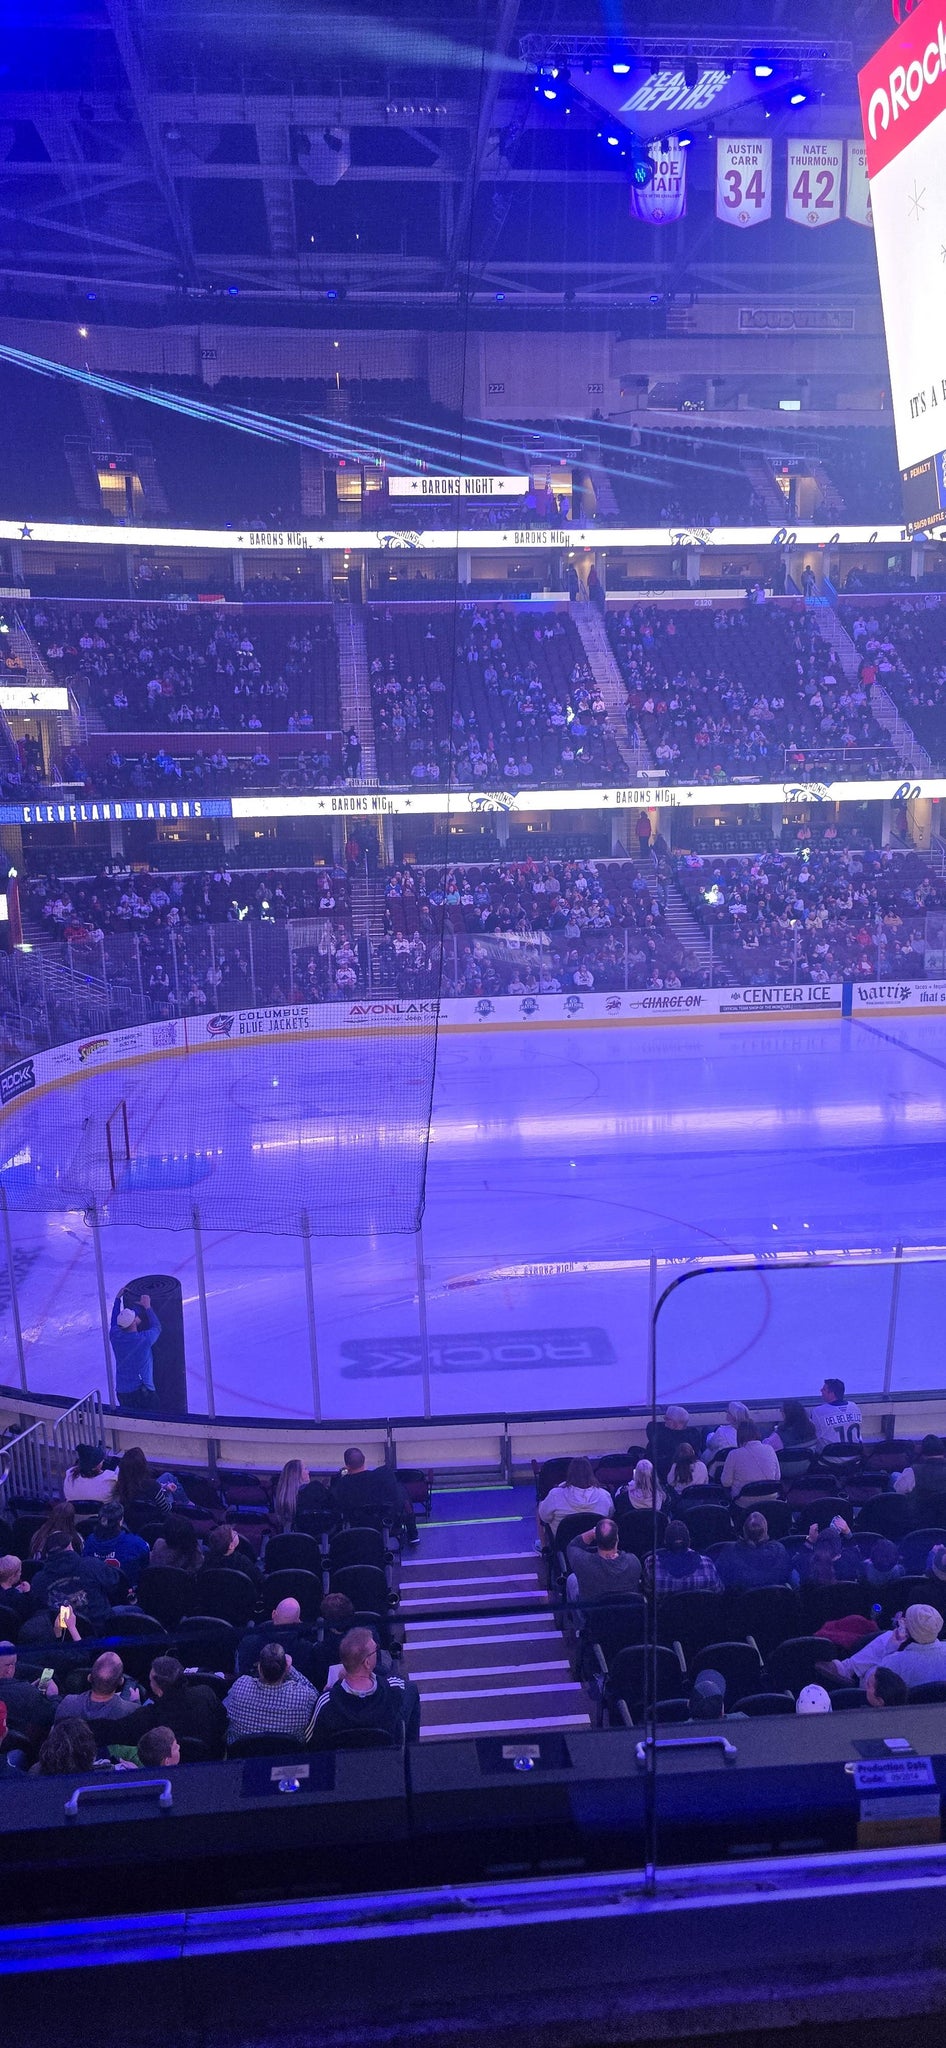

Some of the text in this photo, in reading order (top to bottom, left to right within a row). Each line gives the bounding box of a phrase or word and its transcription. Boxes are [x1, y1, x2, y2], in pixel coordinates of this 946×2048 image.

[644, 71, 692, 87] FEA
[618, 85, 723, 111] DEPTHS
[726, 144, 763, 154] AUSTIN
[802, 145, 827, 155] NATE
[653, 161, 679, 175] JOE
[731, 156, 758, 166] CARR
[790, 156, 839, 166] THURMOND
[650, 177, 682, 191] TAIT
[723, 169, 766, 208] 34
[792, 170, 835, 209] 42
[489, 384, 504, 393] 222
[588, 384, 603, 393] 223
[909, 385, 938, 419] IT'S A
[421, 478, 494, 494] BARONS NIGHT
[927, 512, 944, 526] RAFFLE
[249, 533, 284, 546] BARONS
[514, 531, 547, 544] BARONS
[616, 790, 651, 803] BARONS
[331, 798, 368, 811] BARONS
[23, 801, 202, 823] CLEVELAND BARONS
[743, 986, 831, 1003] CENTER ICE
[919, 991, 938, 1003] that
[642, 995, 702, 1009] CHARGE ON
[239, 1007, 309, 1021] COLUMBUS
[239, 1017, 310, 1034] BLUE JACKETS
[2, 1065, 31, 1093] ROCK
[833, 1423, 861, 1443] 10
[857, 1761, 928, 1773] Production Date
